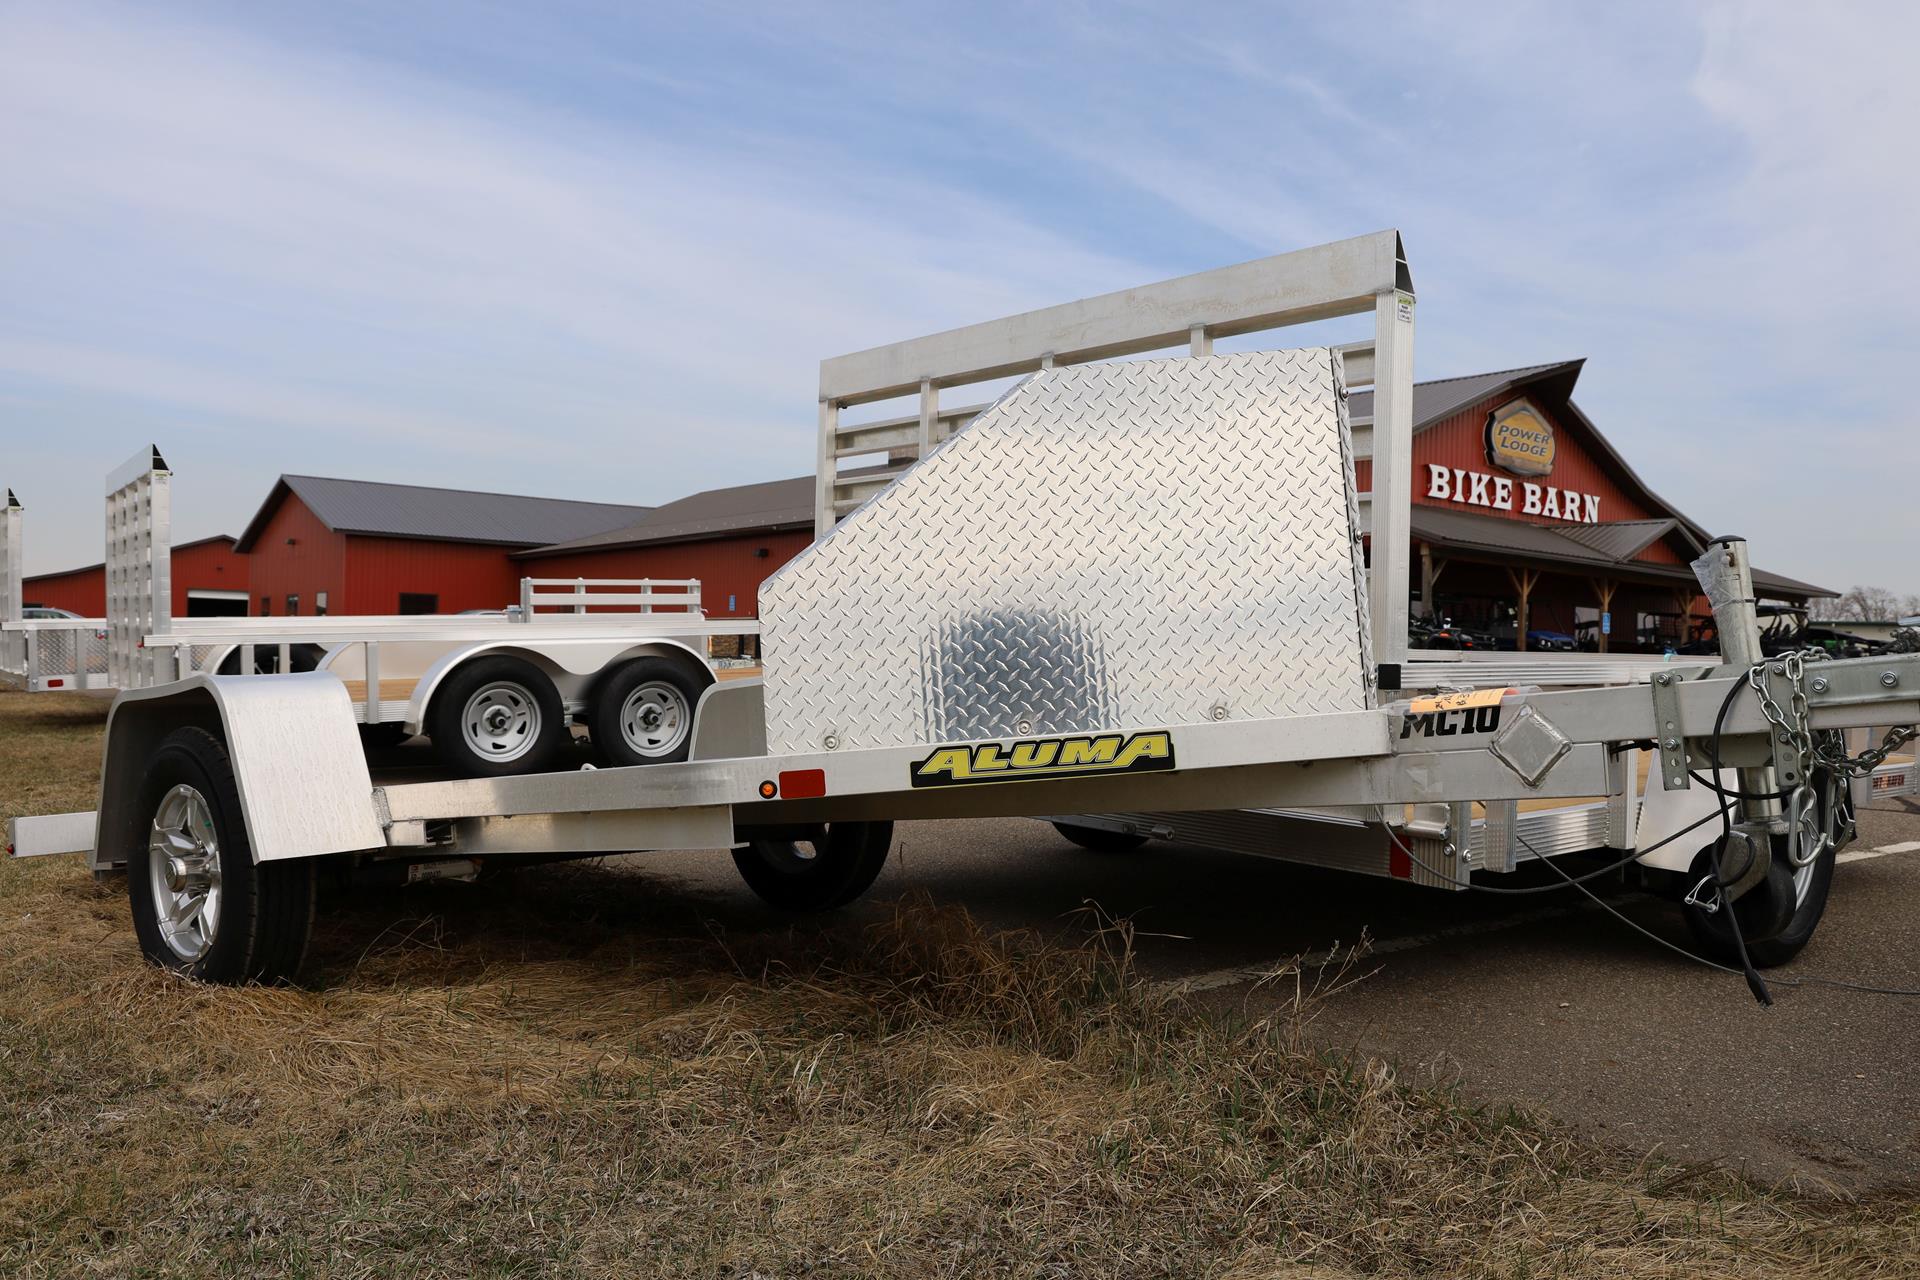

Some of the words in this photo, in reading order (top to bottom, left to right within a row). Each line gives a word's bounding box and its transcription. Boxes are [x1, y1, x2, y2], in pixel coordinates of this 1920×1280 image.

[1498, 424, 1550, 444] POWER
[1501, 437, 1547, 457] LODGE
[1427, 463, 1513, 511] BIKE
[1522, 482, 1600, 523] BARN
[916, 733, 1170, 780] ALUMA
